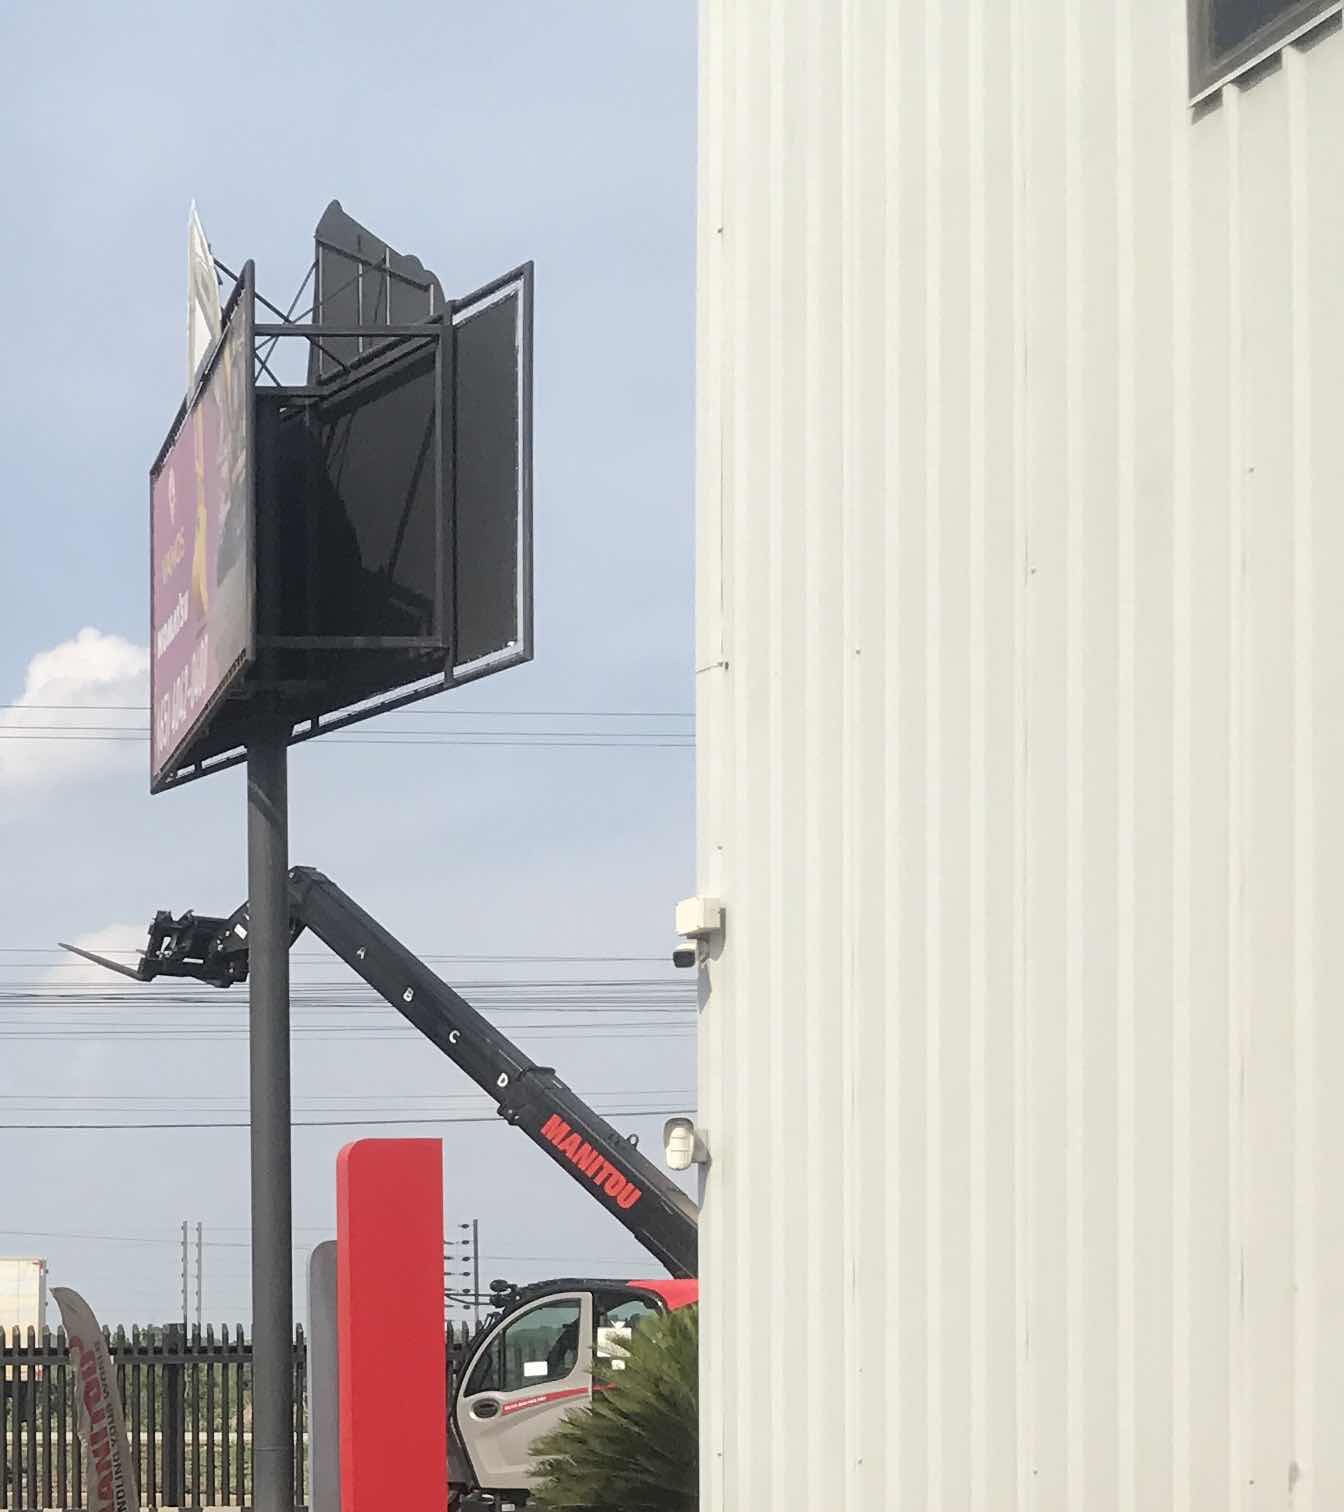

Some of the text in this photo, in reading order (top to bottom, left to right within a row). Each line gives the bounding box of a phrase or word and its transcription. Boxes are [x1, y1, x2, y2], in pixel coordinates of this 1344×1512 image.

[403, 988, 414, 1002] B
[449, 1030, 460, 1043] C
[497, 1072, 509, 1088] D
[540, 1113, 641, 1209] MANITOU
